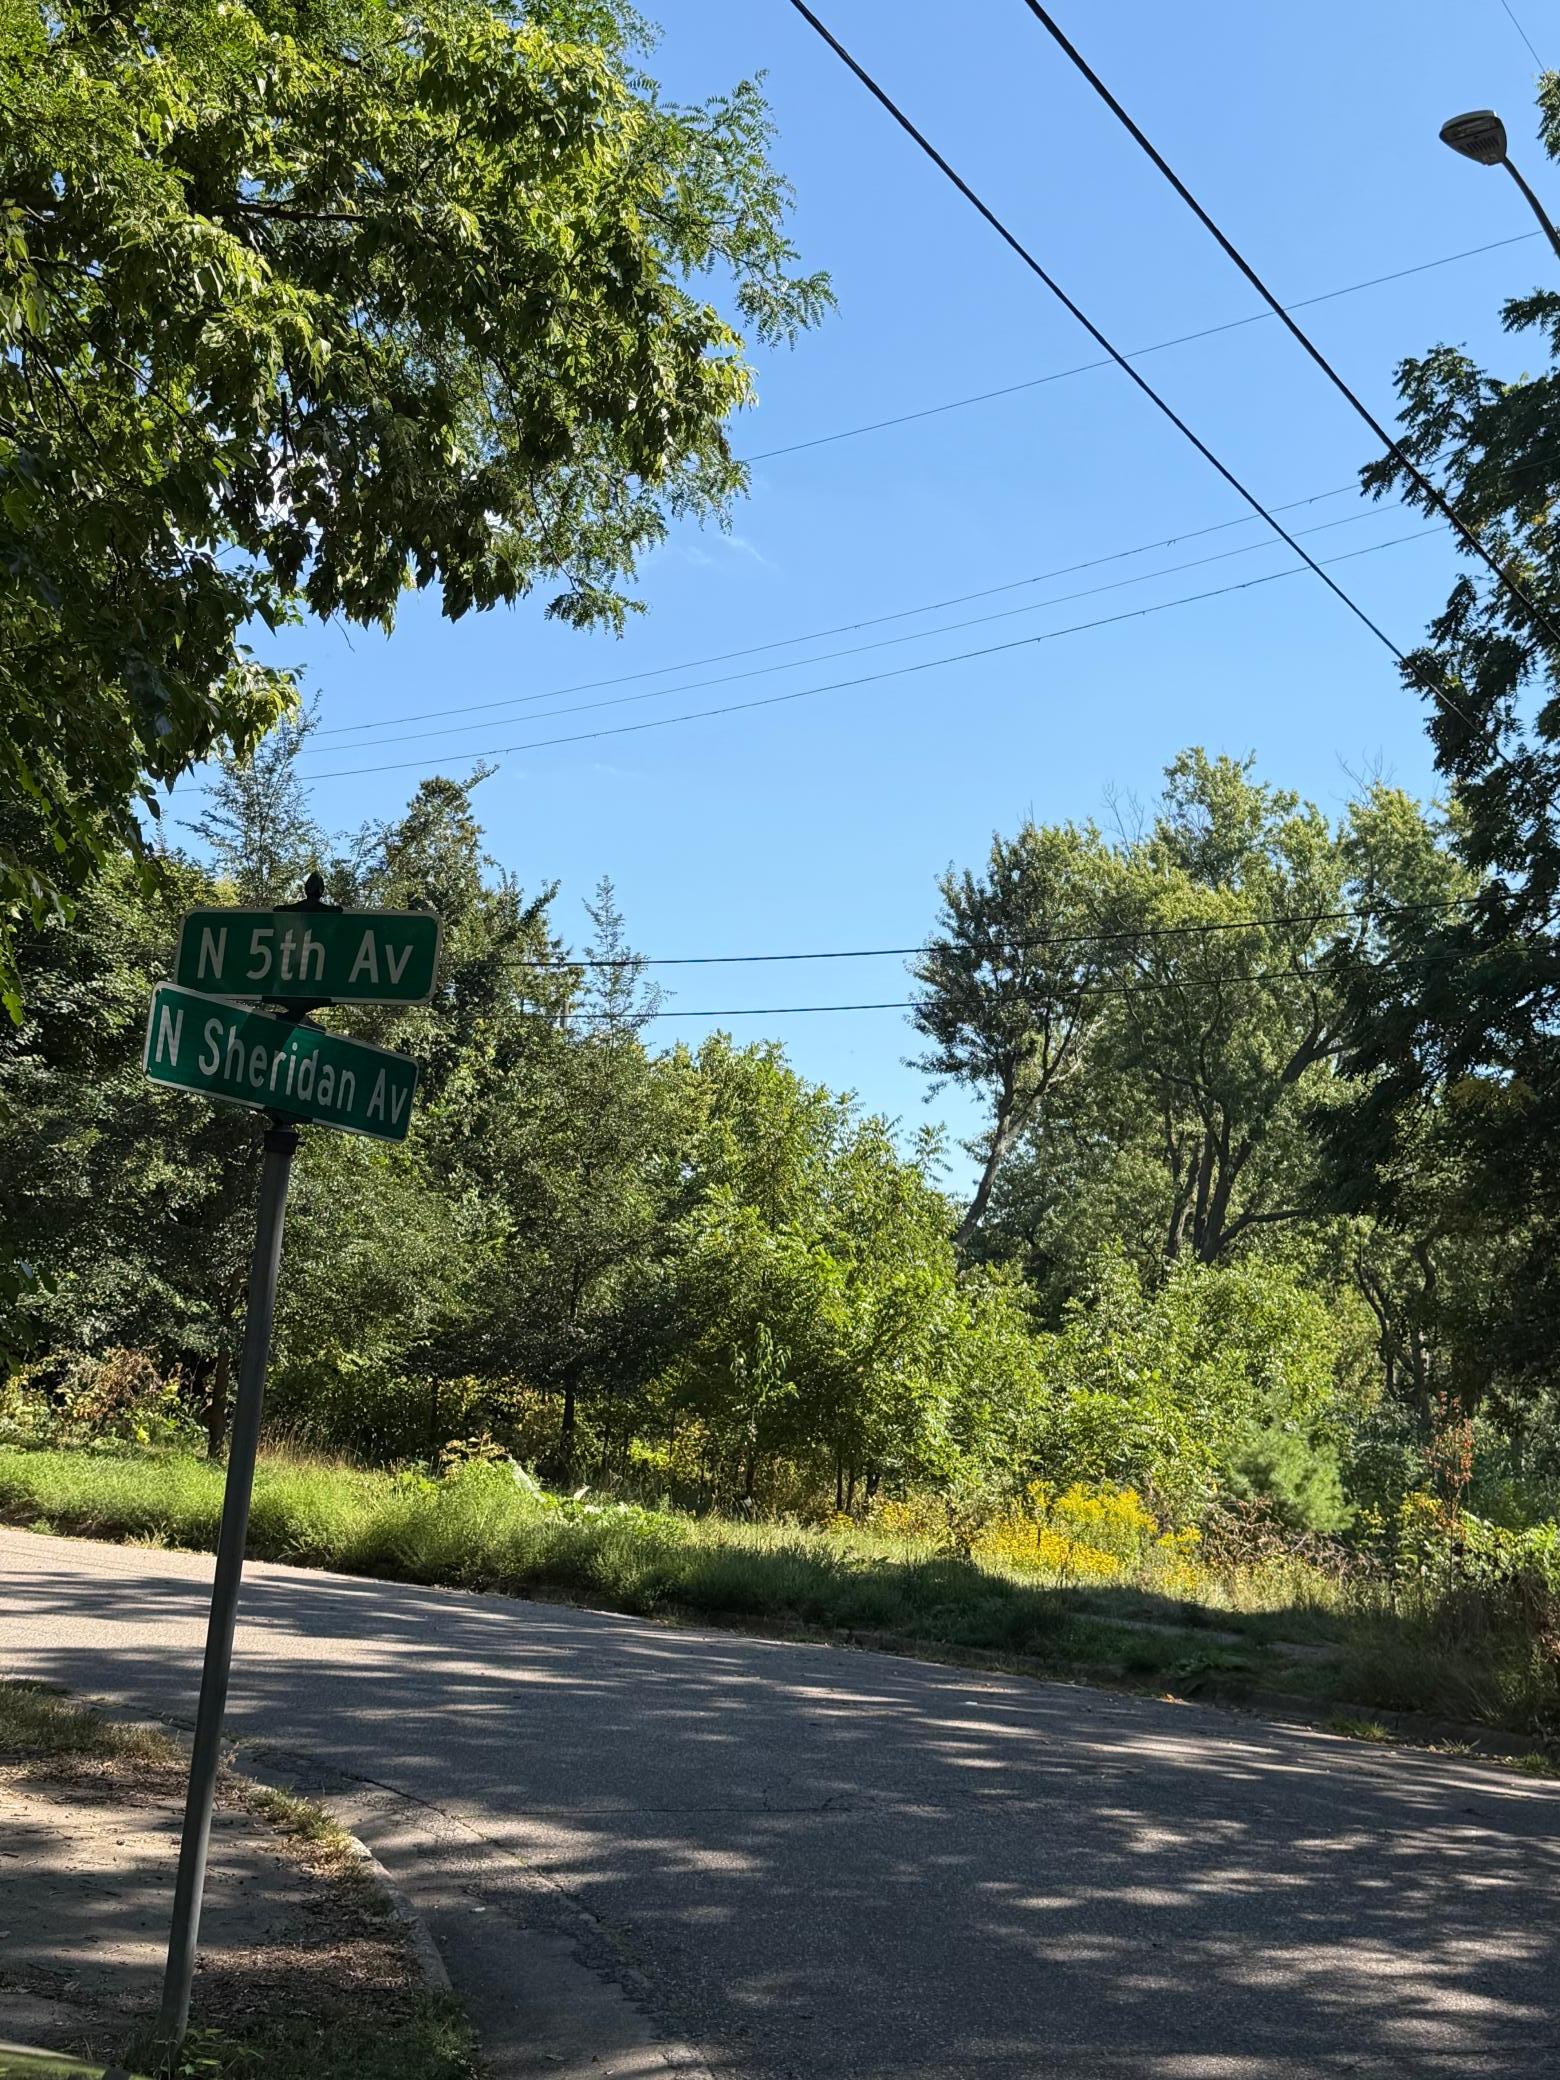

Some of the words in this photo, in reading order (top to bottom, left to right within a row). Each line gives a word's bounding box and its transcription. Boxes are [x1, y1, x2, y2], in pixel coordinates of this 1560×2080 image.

[197, 927, 228, 979] N
[246, 928, 326, 981] 5th
[348, 929, 414, 984] Av
[155, 1005, 184, 1067] N
[198, 1017, 356, 1112] Sheridan
[366, 1068, 408, 1125] Av
